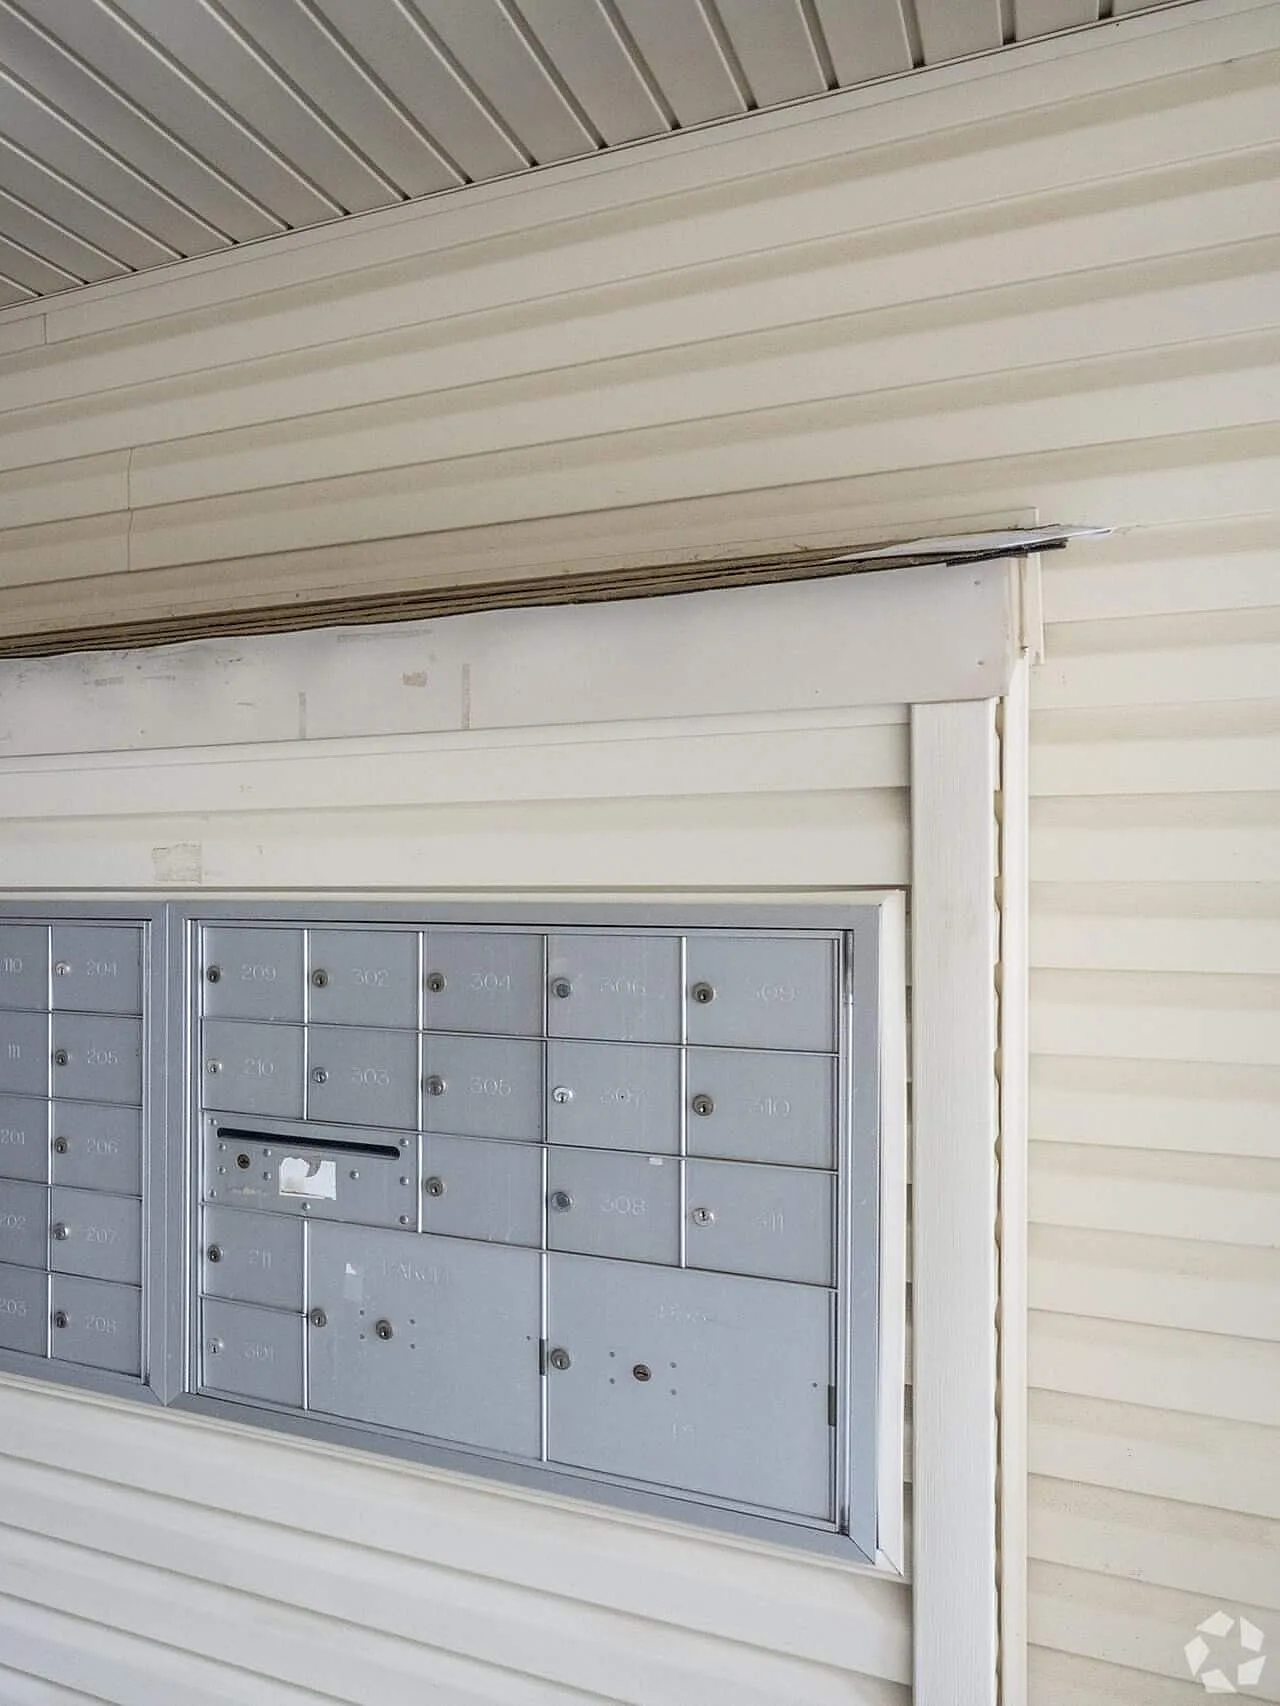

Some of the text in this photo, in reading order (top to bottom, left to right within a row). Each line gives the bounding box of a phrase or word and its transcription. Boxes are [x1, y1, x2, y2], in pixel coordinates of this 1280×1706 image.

[240, 964, 277, 983] 209
[350, 968, 391, 988] 302
[470, 970, 511, 992] 304
[87, 1048, 119, 1066] 205
[350, 1065, 391, 1086] 303
[469, 1076, 511, 1097] 305
[0, 1129, 25, 1146] 201
[599, 1192, 647, 1216] 308
